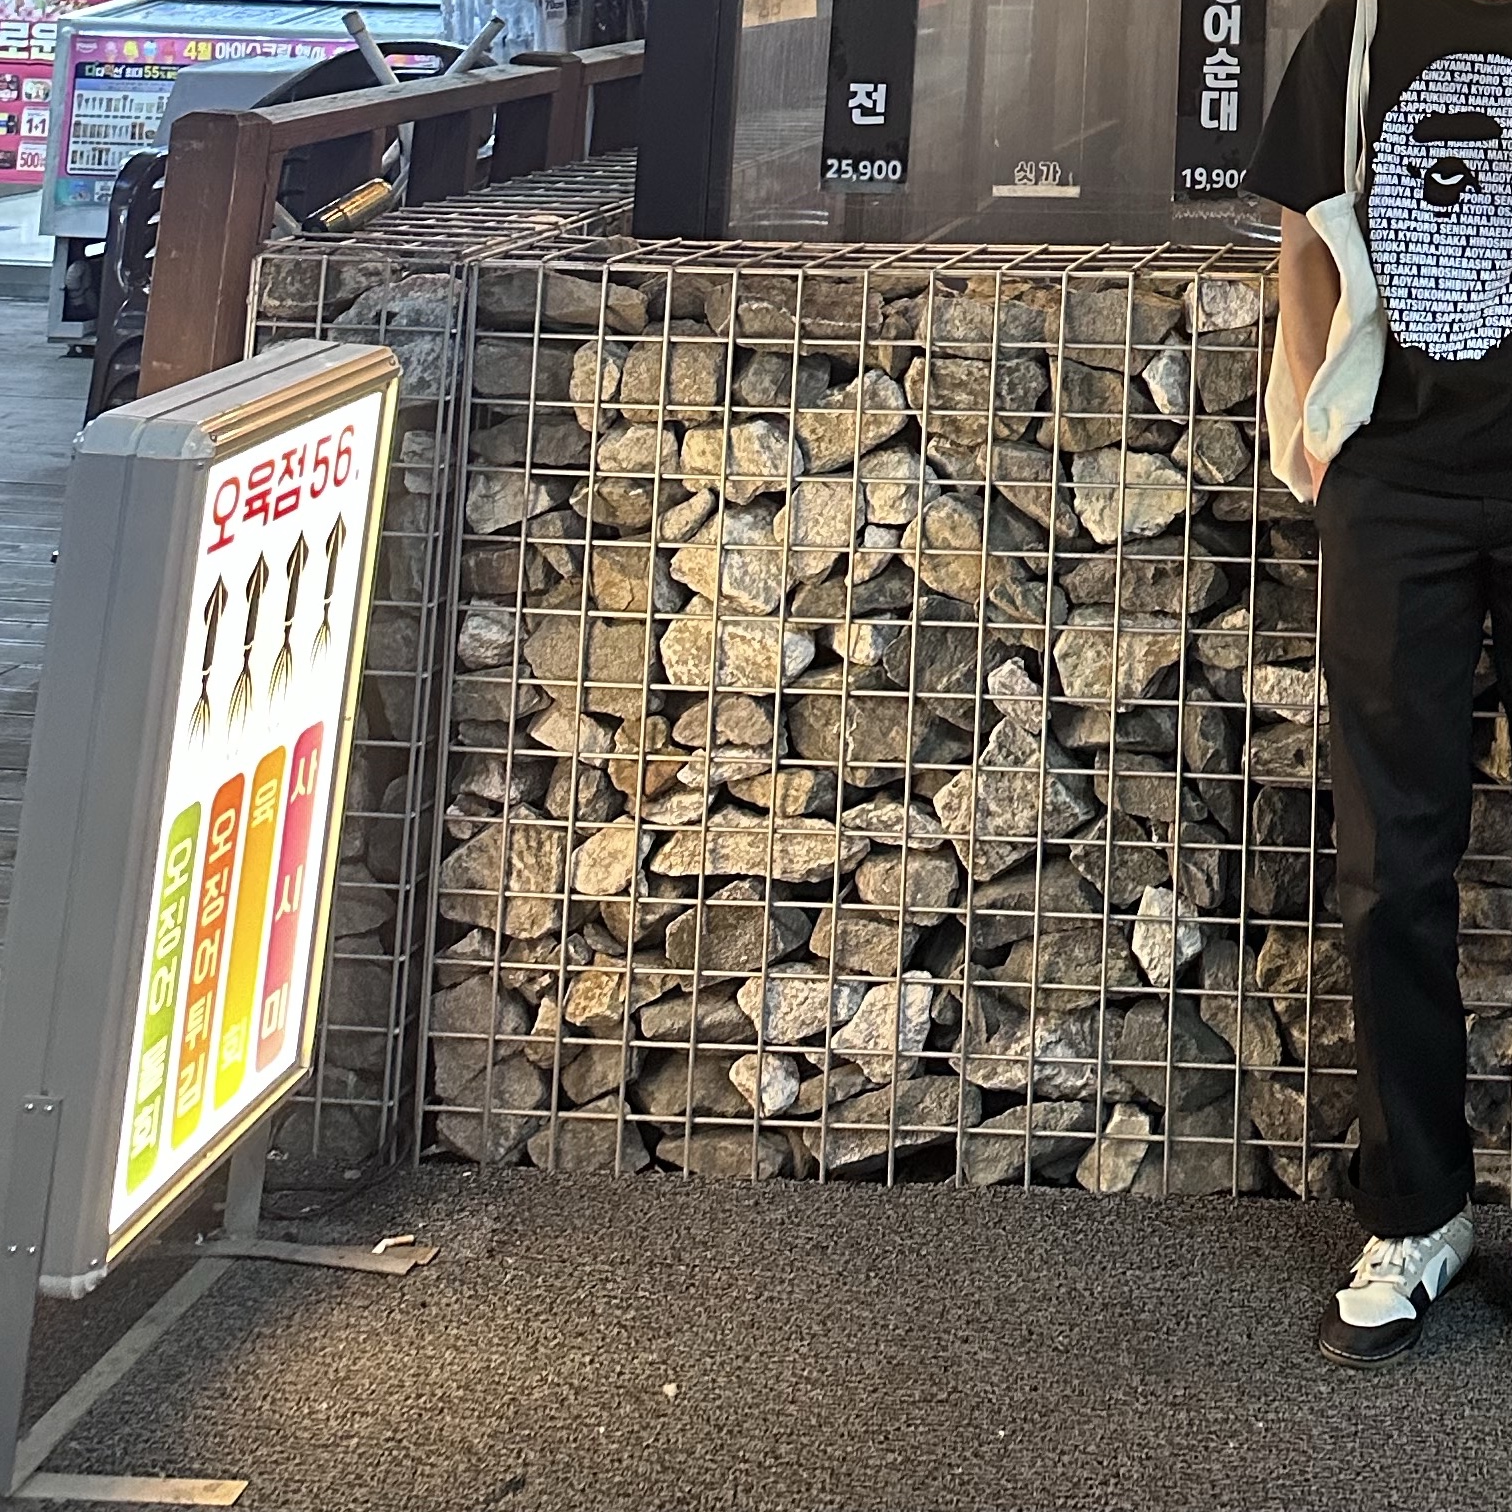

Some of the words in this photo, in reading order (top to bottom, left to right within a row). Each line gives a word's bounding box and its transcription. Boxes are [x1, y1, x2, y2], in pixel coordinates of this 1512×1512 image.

[183, 43, 212, 61] 4월
[1453, 72, 1500, 85] SAPPORO
[1428, 82, 1469, 94] NAGOYA
[1471, 84, 1503, 96] KYOTO
[1420, 91, 1466, 105] FUKUOKA
[1400, 102, 1446, 114] SAPPORO
[1393, 144, 1427, 157] OSAKA
[1428, 147, 1485, 159] HIROSHIMA
[826, 159, 902, 181] 25,900
[1462, 203, 1495, 215] KYOTO
[1390, 219, 1437, 233] SAPPORO
[1440, 223, 1477, 236] SENDAI
[1397, 230, 1430, 243] KYOTO
[1432, 233, 1467, 246] OSAKA
[1408, 242, 1462, 257] HARAJUKU
[1464, 246, 1508, 259] AOYAMA
[1399, 253, 1437, 265] SENDAI
[1438, 256, 1492, 269] MAEBASHI
[1383, 263, 1418, 275] OSAKA
[1420, 265, 1478, 280] HIROSHIMA
[1391, 275, 1436, 288] AOYAMA
[1438, 278, 1482, 291] SHIBUYA
[1410, 288, 1468, 301] YOKOHAMA
[1389, 298, 1455, 312] MATSUYAMA
[1402, 310, 1433, 322] GINZA
[1408, 321, 1450, 333] NAGOYA
[1400, 331, 1447, 343] FUKUOKA
